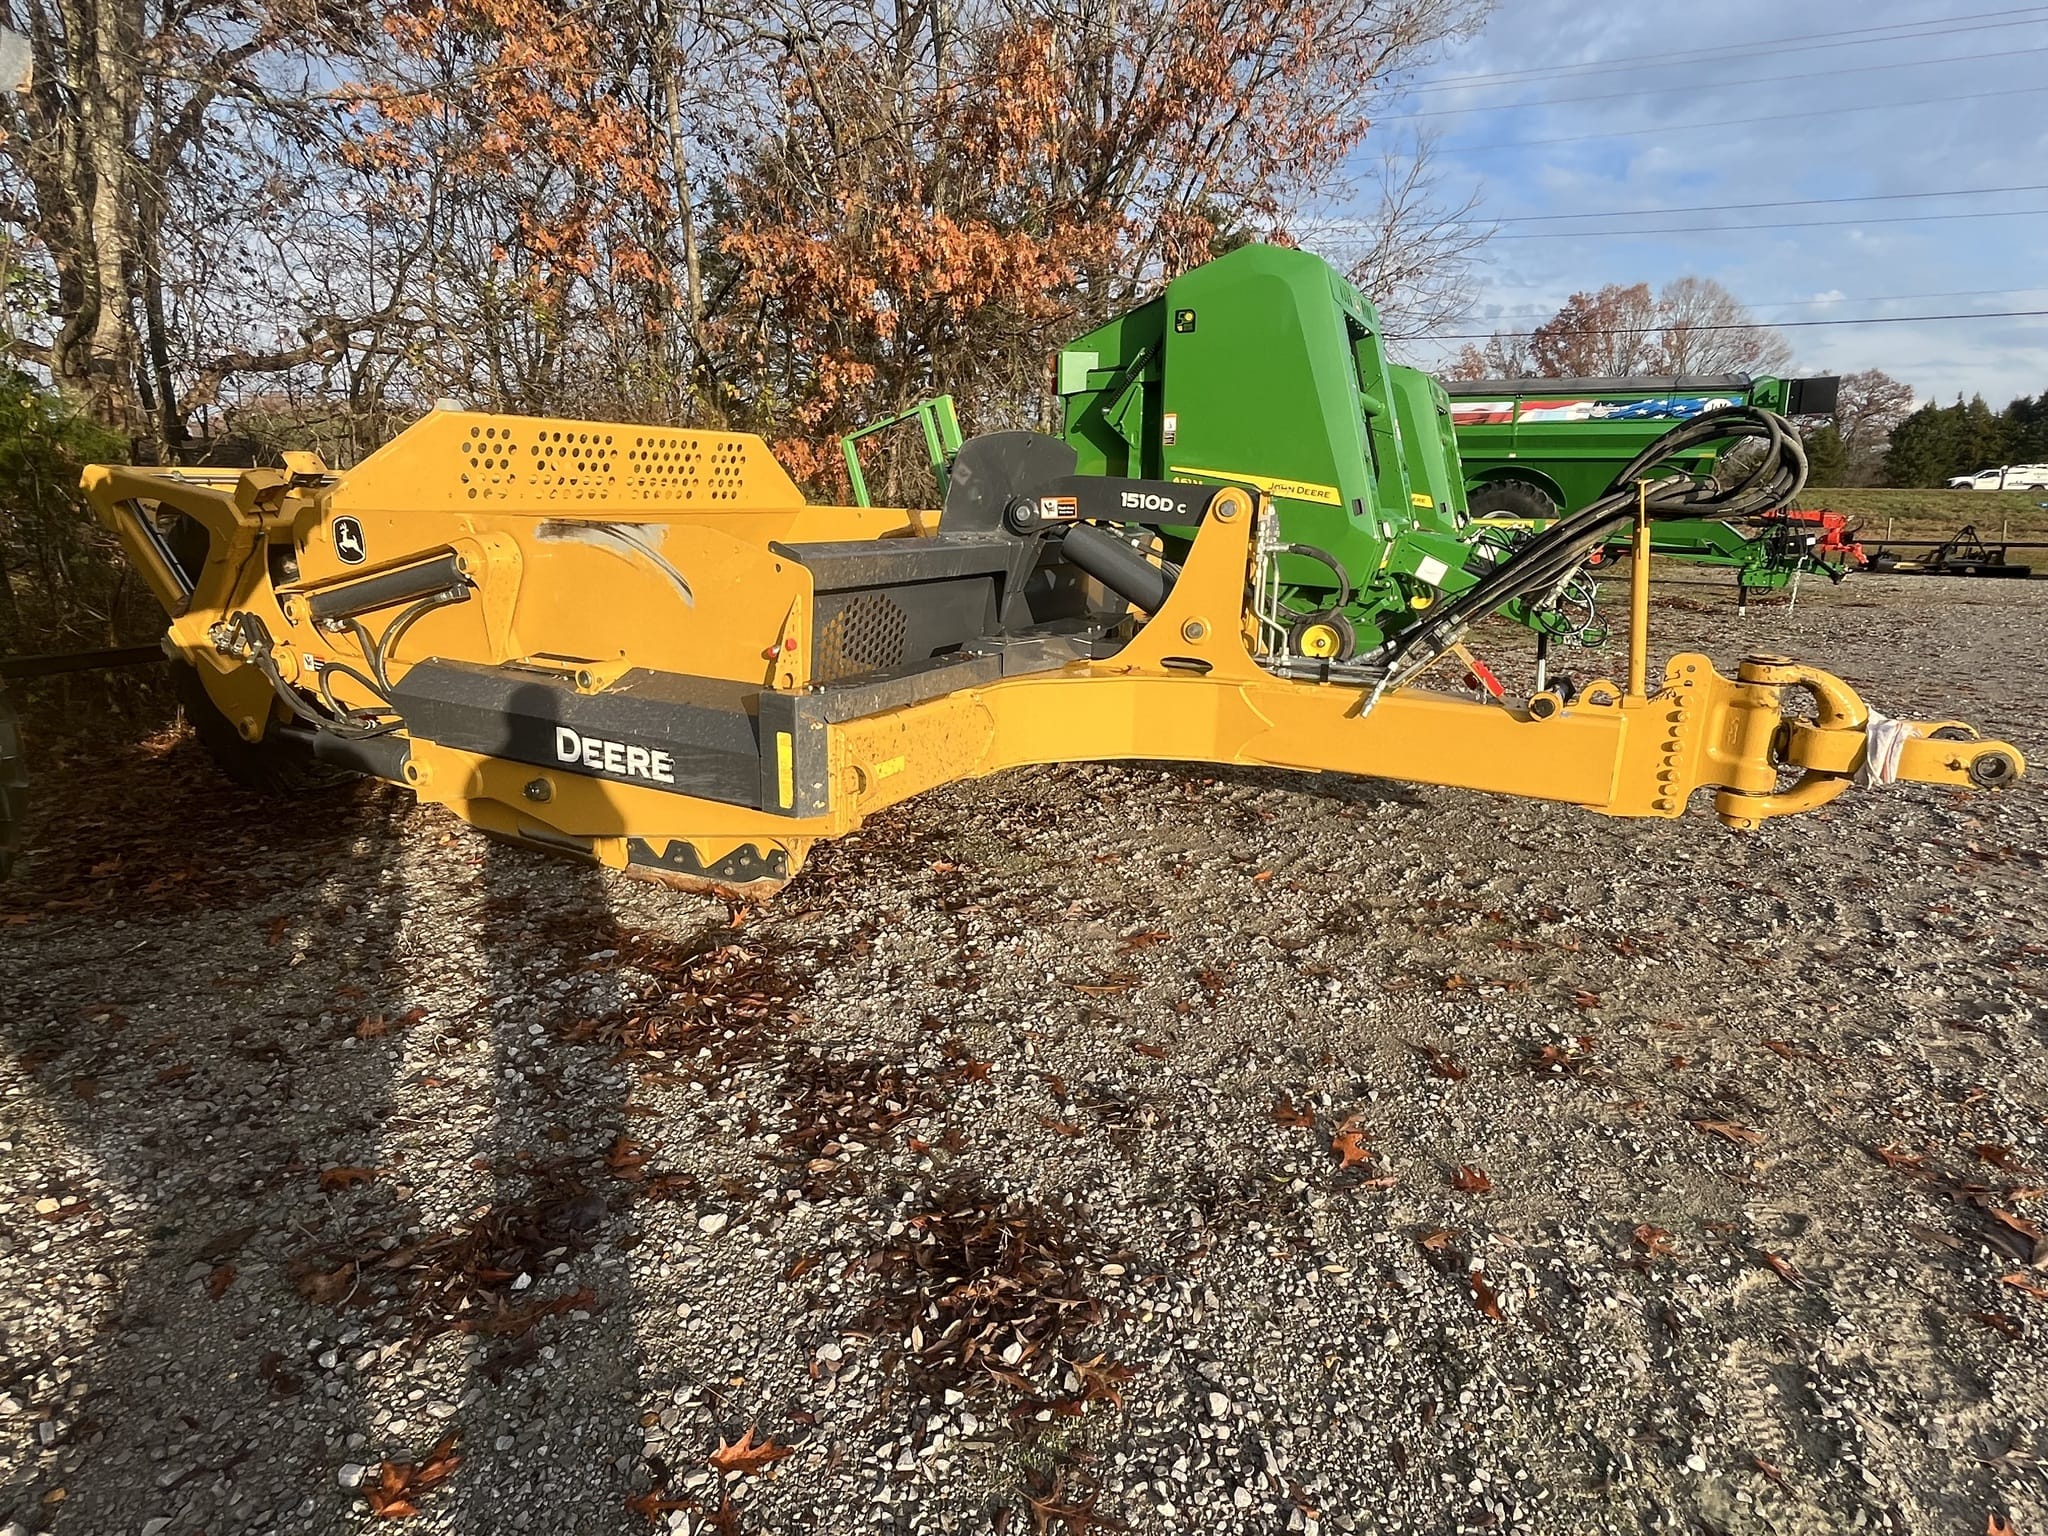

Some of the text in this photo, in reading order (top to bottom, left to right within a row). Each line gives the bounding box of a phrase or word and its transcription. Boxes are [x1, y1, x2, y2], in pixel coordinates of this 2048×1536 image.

[1268, 482, 1331, 498] JOHN DEERE
[1121, 491, 1174, 512] 1510D
[555, 725, 676, 784] DEERE
